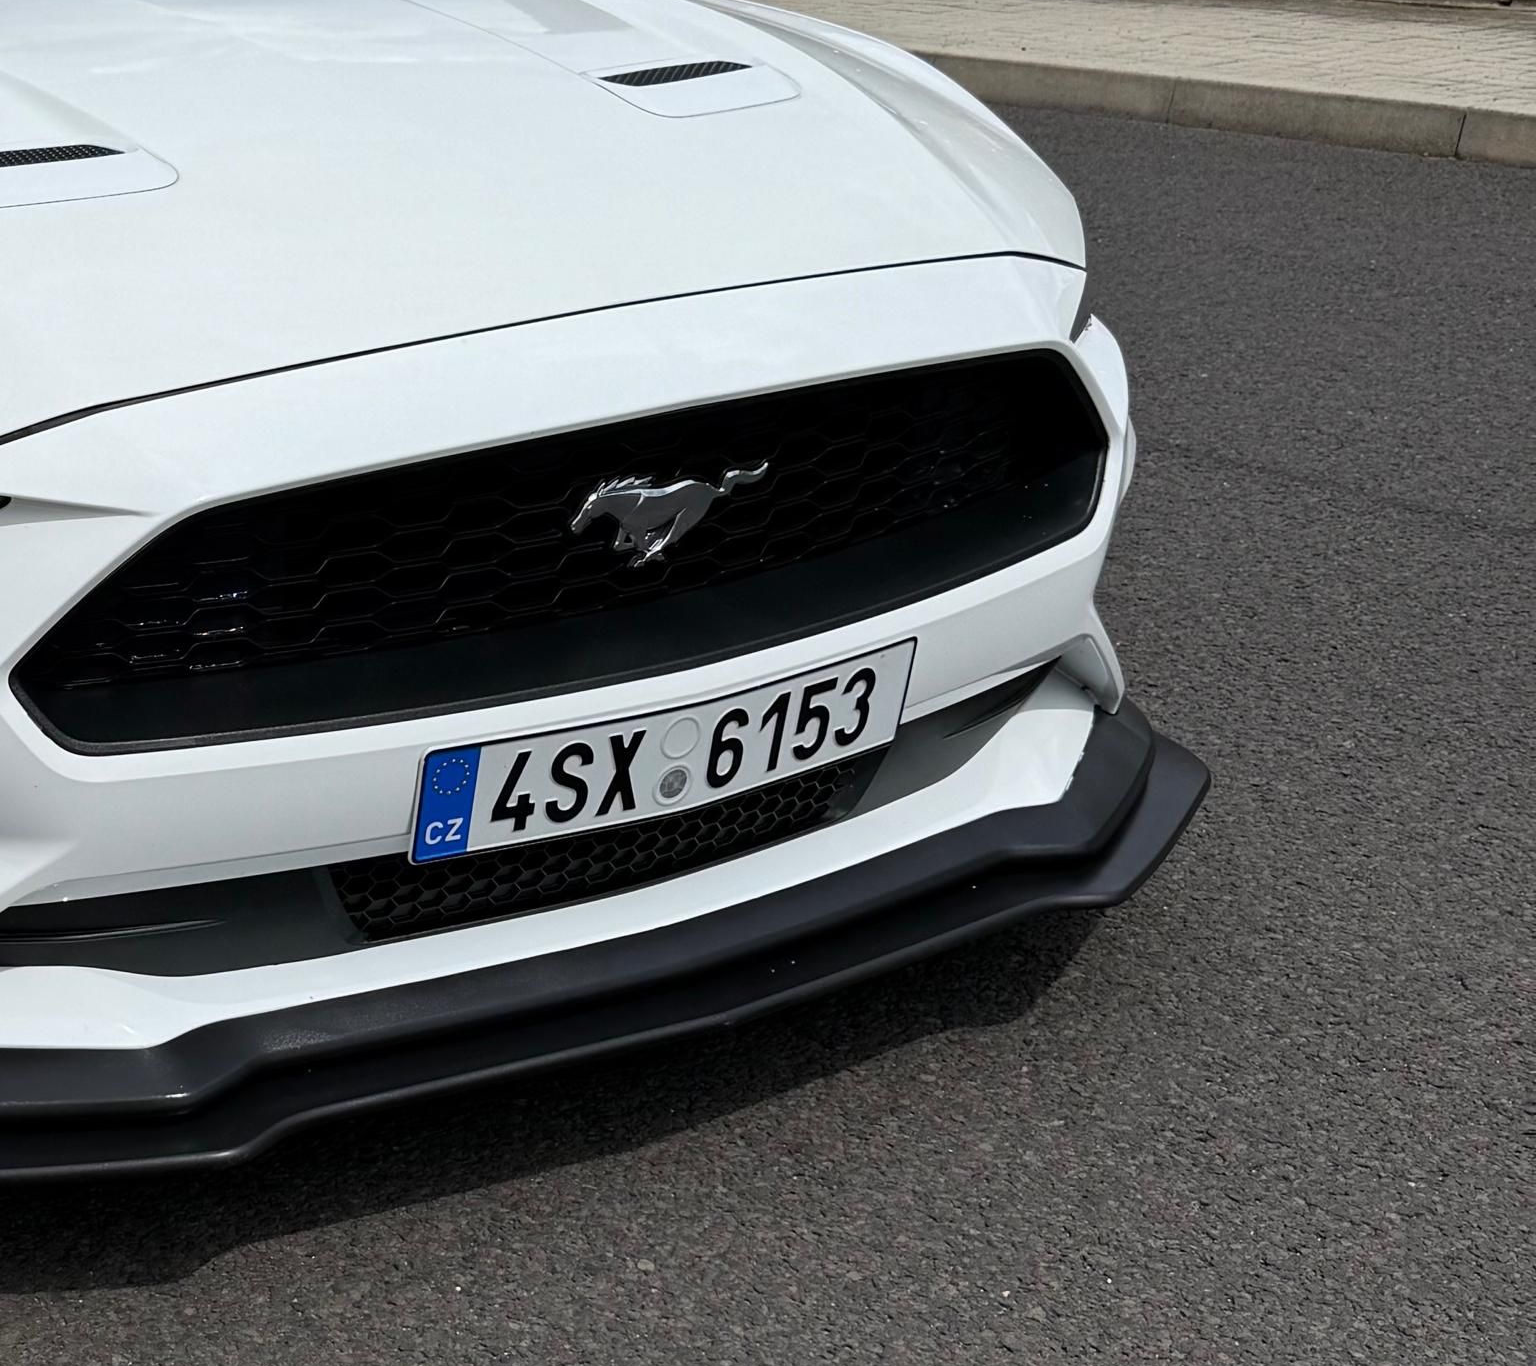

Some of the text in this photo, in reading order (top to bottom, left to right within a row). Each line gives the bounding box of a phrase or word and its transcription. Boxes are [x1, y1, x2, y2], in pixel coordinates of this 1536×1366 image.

[490, 667, 876, 831] 4SX 6153
[425, 817, 463, 844] CZ
